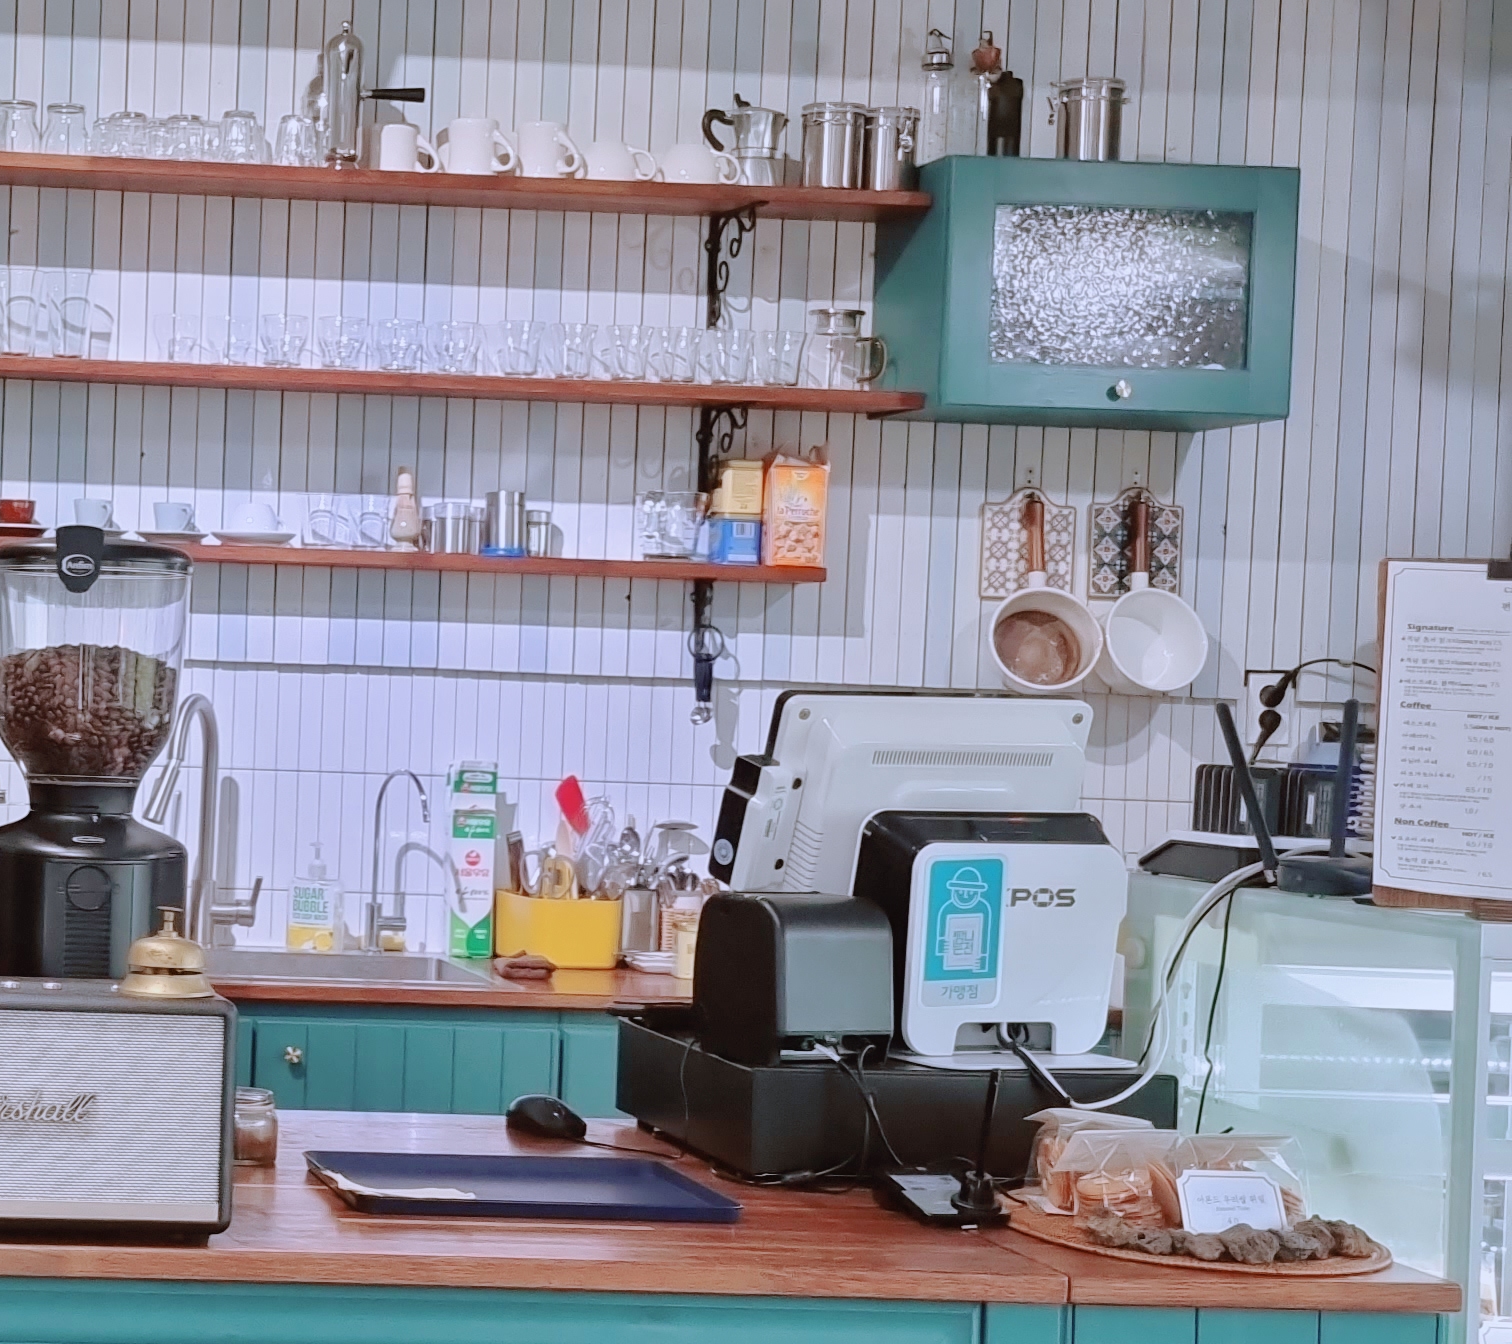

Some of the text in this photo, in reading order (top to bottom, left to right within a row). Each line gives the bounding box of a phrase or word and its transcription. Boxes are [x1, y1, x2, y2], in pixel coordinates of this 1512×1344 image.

[1407, 623, 1454, 633] Signature
[1400, 701, 1432, 710] Coffee
[1394, 817, 1450, 828] Non Coffee
[293, 886, 325, 900] SUGAR
[1006, 887, 1077, 908] POS
[292, 899, 329, 914] BUBBLE
[941, 984, 978, 1000] 가맹점
